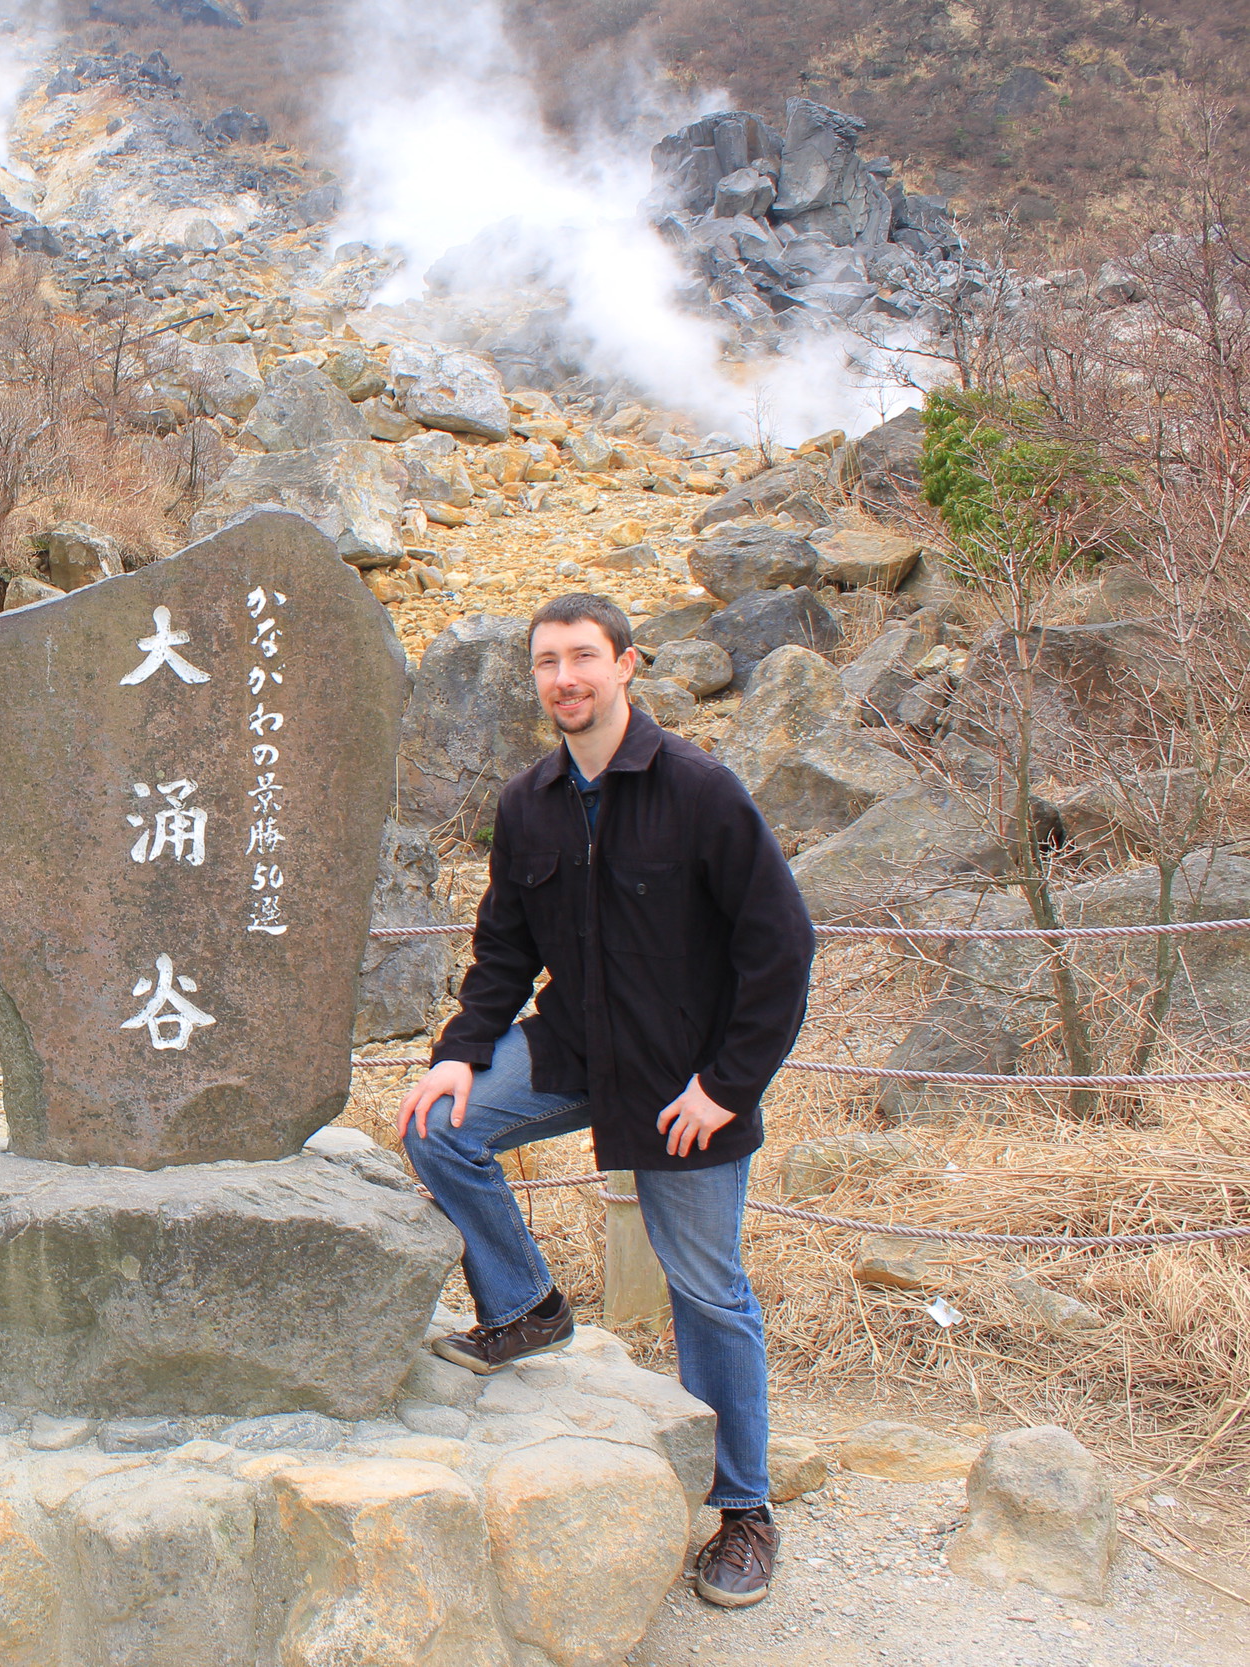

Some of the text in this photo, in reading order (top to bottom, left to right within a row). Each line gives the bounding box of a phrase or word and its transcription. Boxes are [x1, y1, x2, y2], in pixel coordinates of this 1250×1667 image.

[119, 605, 217, 1051] 大涌谷
[246, 585, 288, 936] かながわの景勝50選
